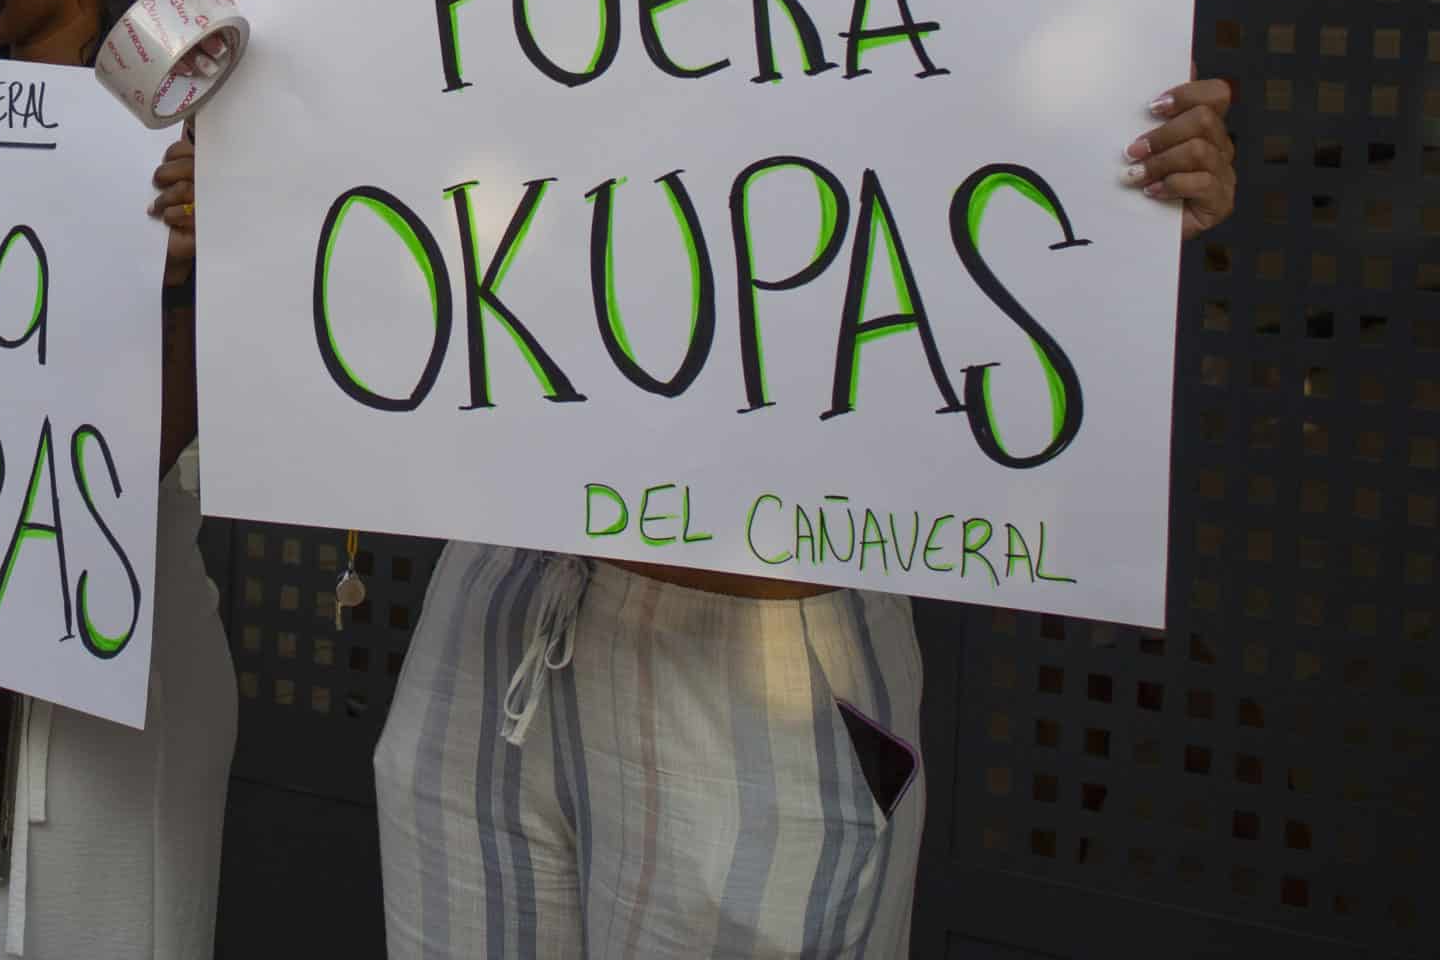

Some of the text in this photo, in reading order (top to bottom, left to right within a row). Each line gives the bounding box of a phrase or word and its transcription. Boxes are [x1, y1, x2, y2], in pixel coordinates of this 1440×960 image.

[313, 155, 1092, 468] OKUPAS
[585, 483, 1077, 585] DEL CAÑAVERAL
